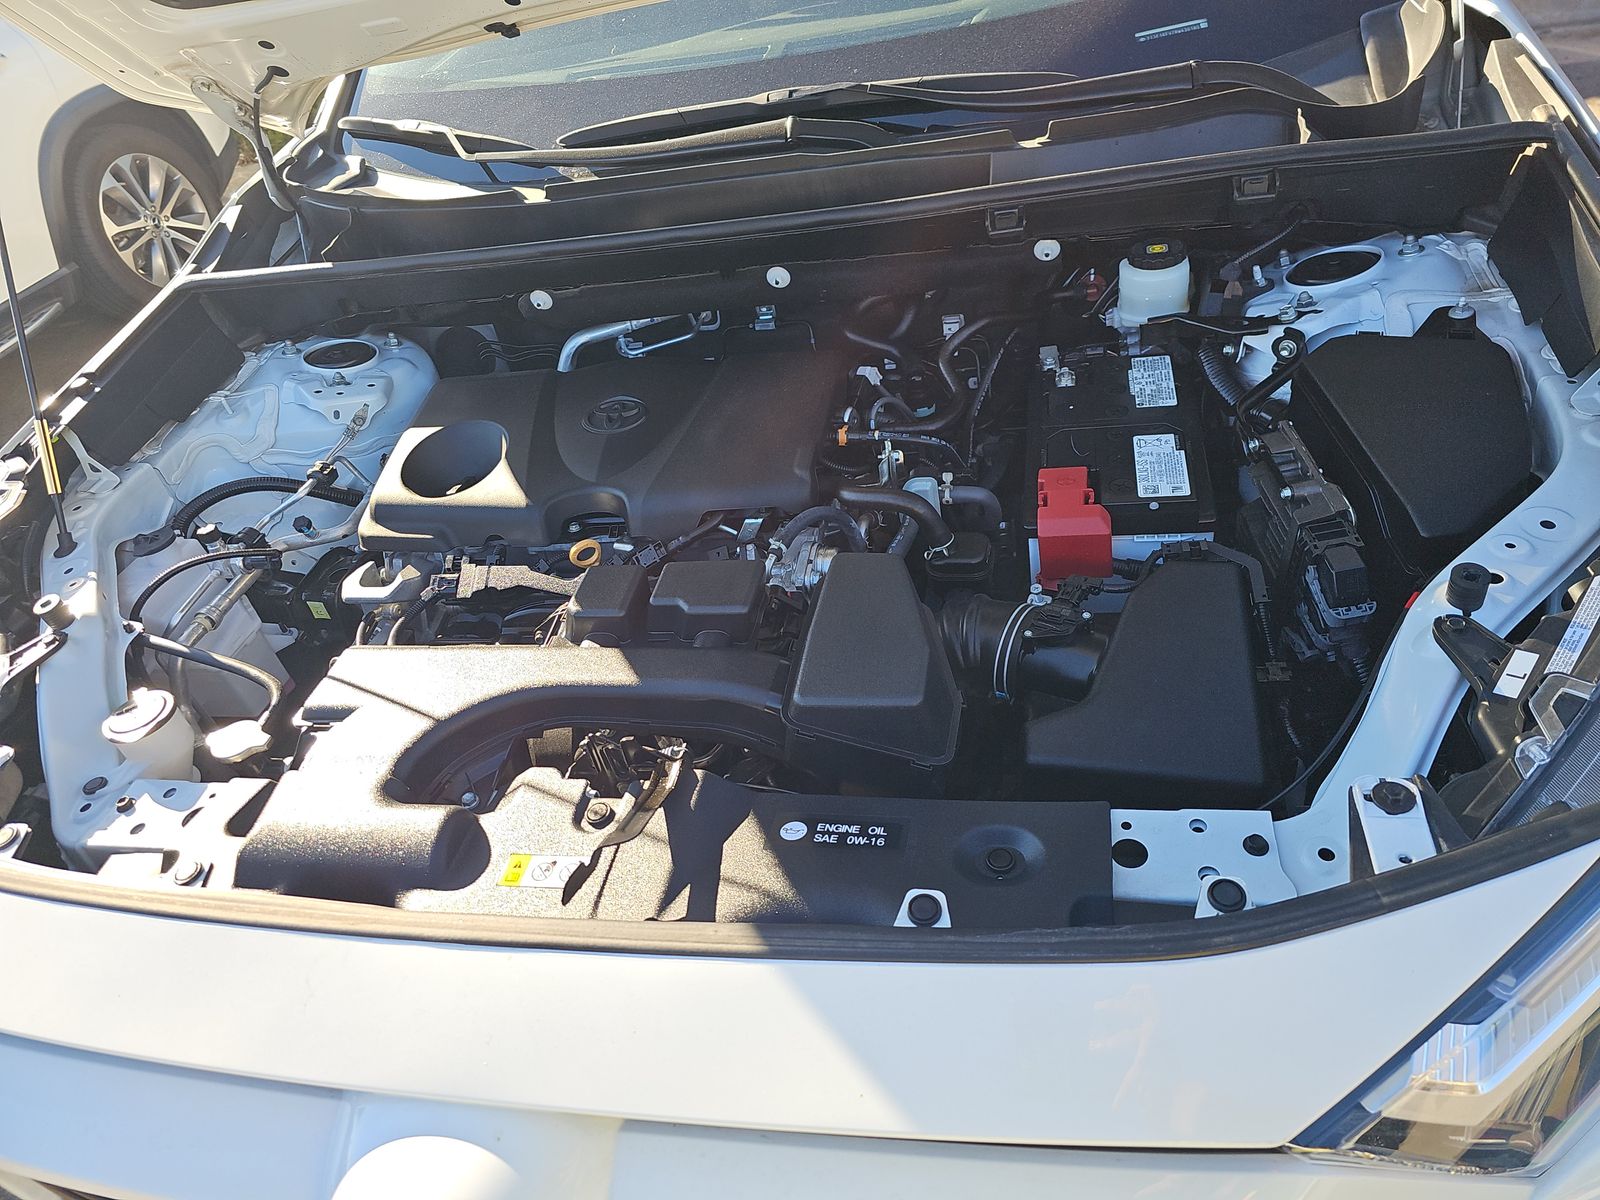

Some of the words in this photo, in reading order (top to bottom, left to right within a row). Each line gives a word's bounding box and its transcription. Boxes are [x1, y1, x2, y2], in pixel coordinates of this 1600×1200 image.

[816, 823, 861, 834] ENGINE
[868, 826, 888, 836] OIL
[813, 833, 839, 843] SAE
[846, 835, 885, 846] 0W-16
